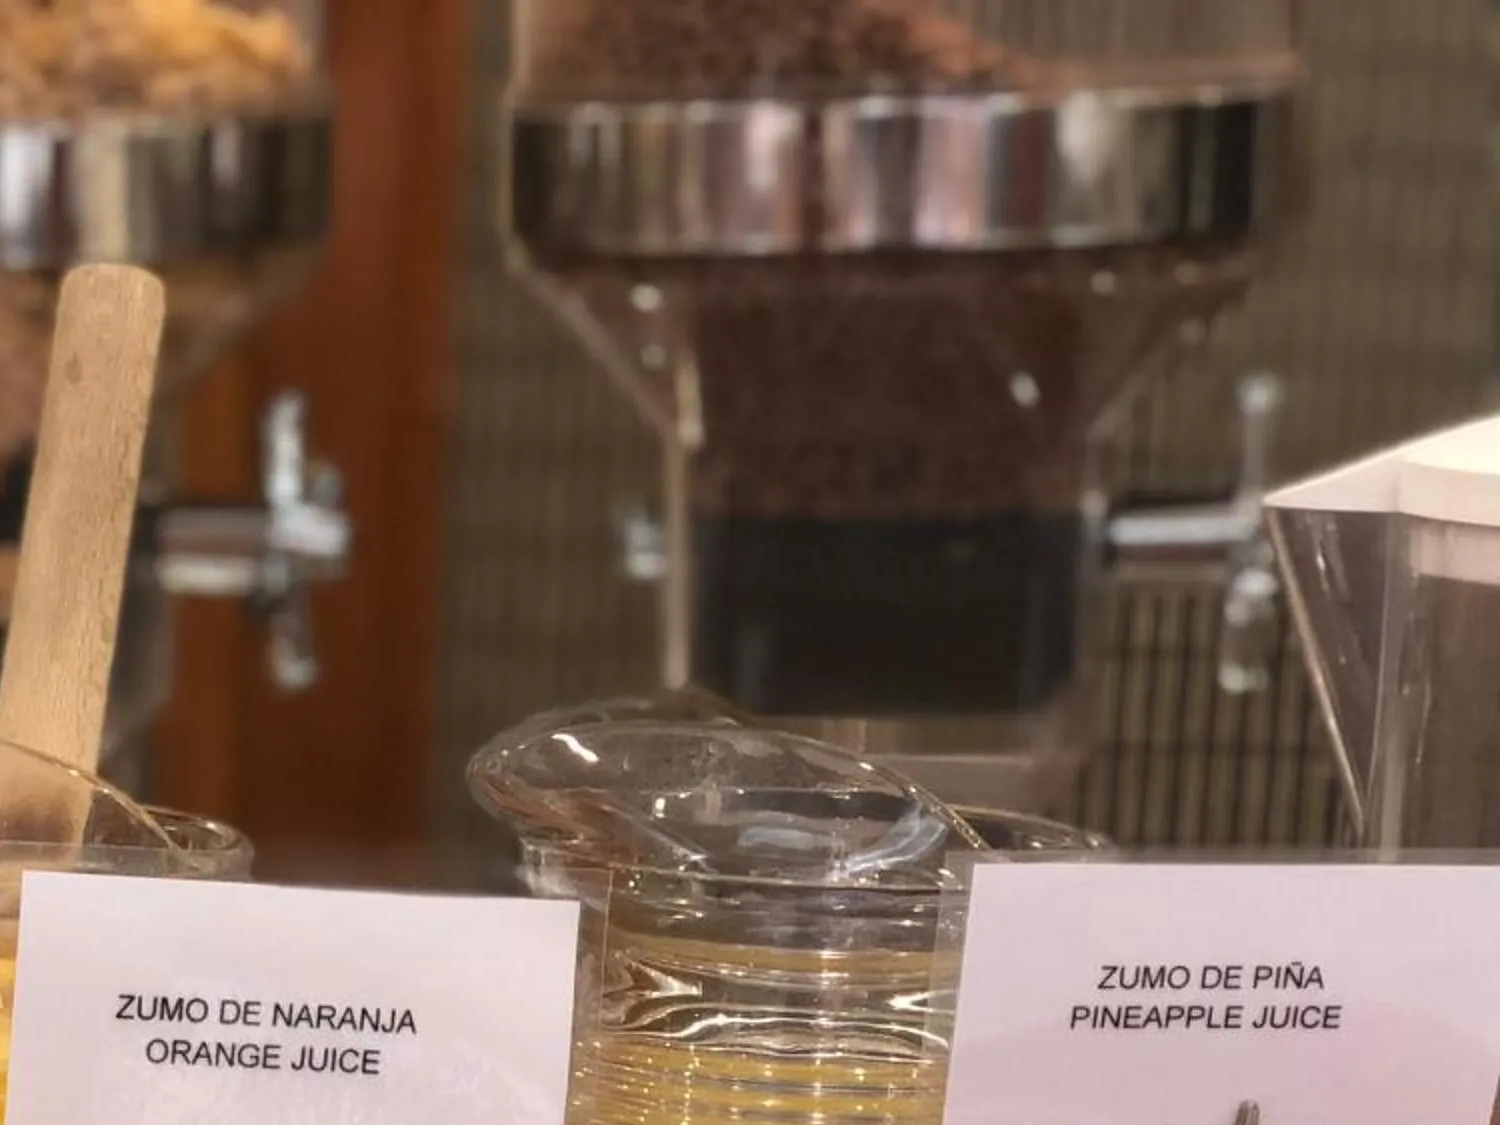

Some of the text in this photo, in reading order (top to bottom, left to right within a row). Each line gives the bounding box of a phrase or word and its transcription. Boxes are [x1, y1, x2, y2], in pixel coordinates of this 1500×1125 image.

[1097, 961, 1324, 990] ZUMO DE PIÑA
[116, 994, 417, 1034] ZUMO DE NARANJA
[1070, 1005, 1343, 1030] PINEAPPLE JUICE
[146, 1038, 380, 1075] ORANGE JUICE
